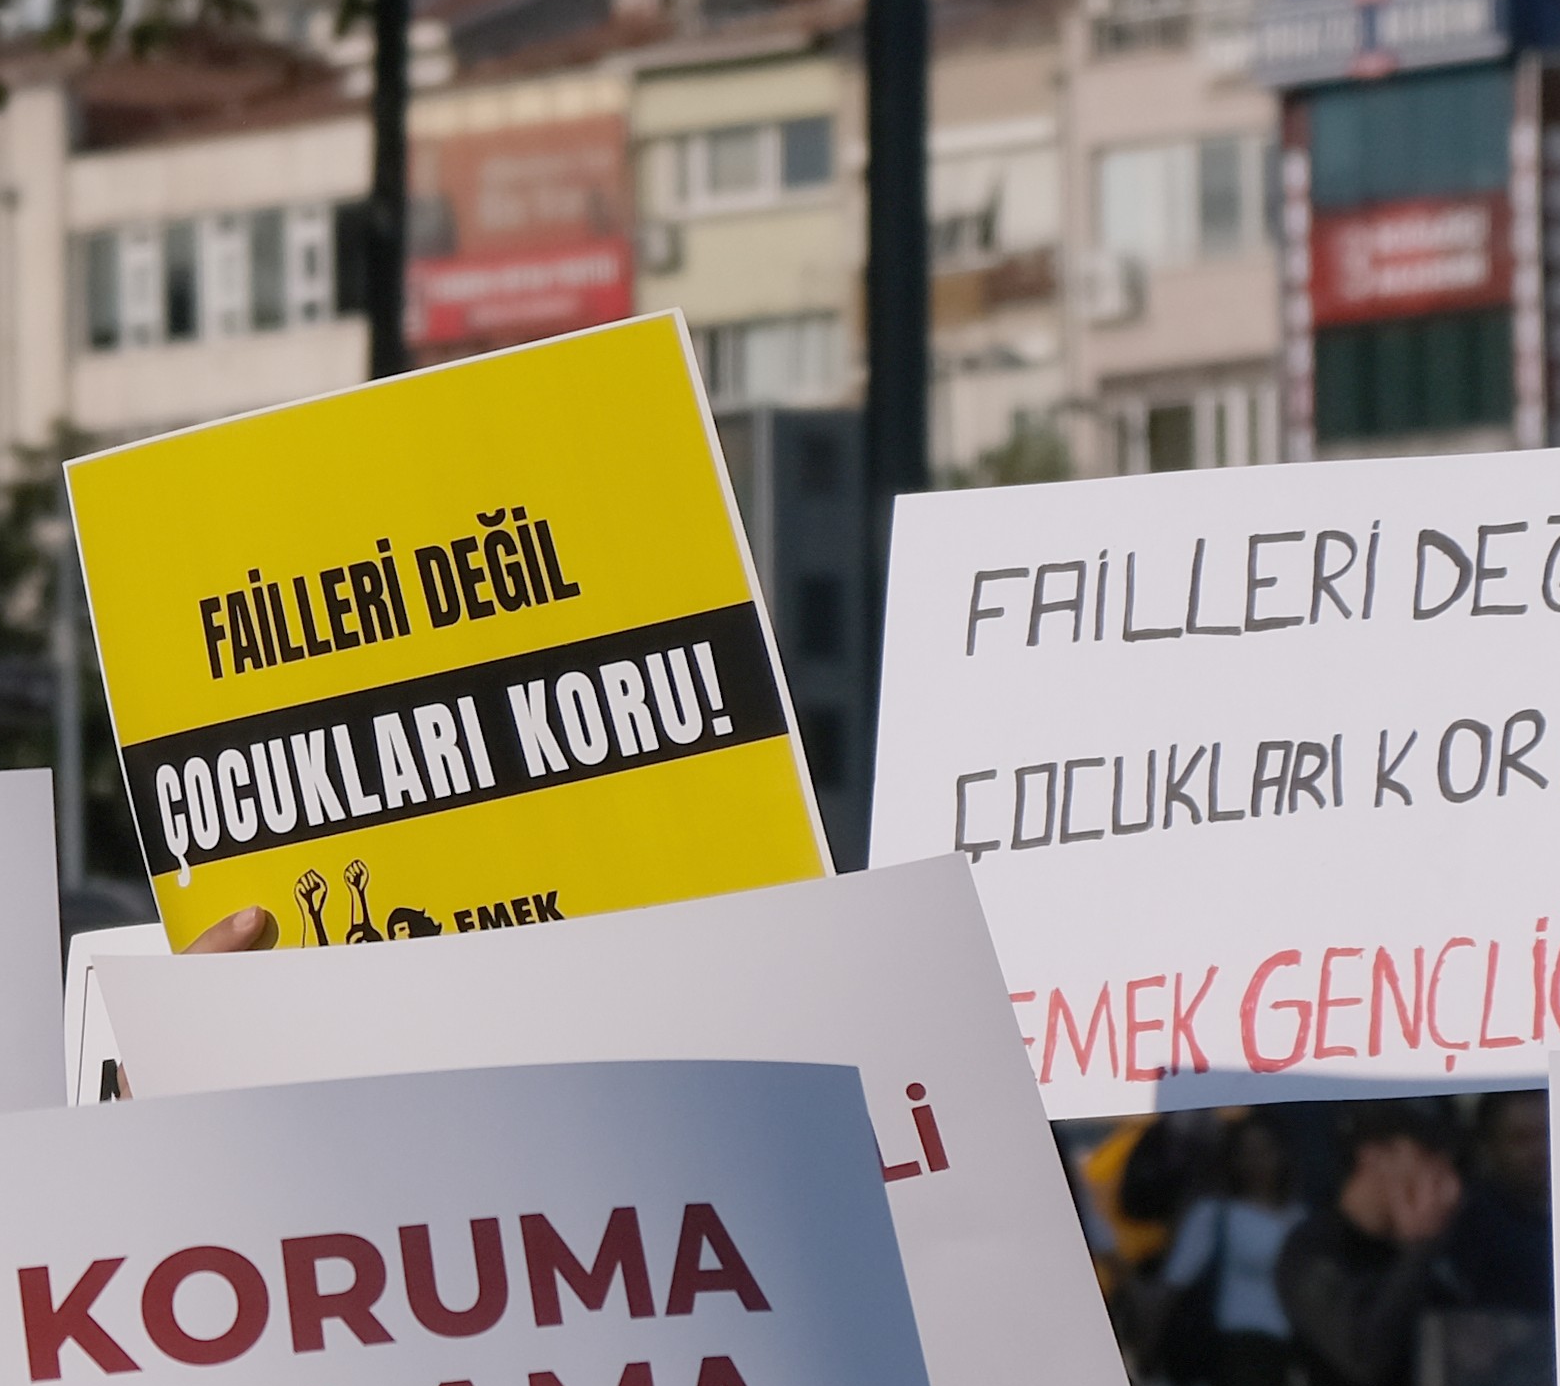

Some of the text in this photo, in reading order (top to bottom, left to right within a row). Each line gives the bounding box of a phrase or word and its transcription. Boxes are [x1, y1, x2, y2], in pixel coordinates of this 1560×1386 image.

[198, 505, 581, 680] FAİLLERİ DEĞİL
[966, 520, 1381, 657] FAİLLERİ
[155, 641, 735, 888] ÇOCUKLARI KORU!
[953, 734, 1344, 865] ÇOCUKLARI
[453, 890, 566, 933] EMEK
[16, 1201, 773, 1385] KORUMA
